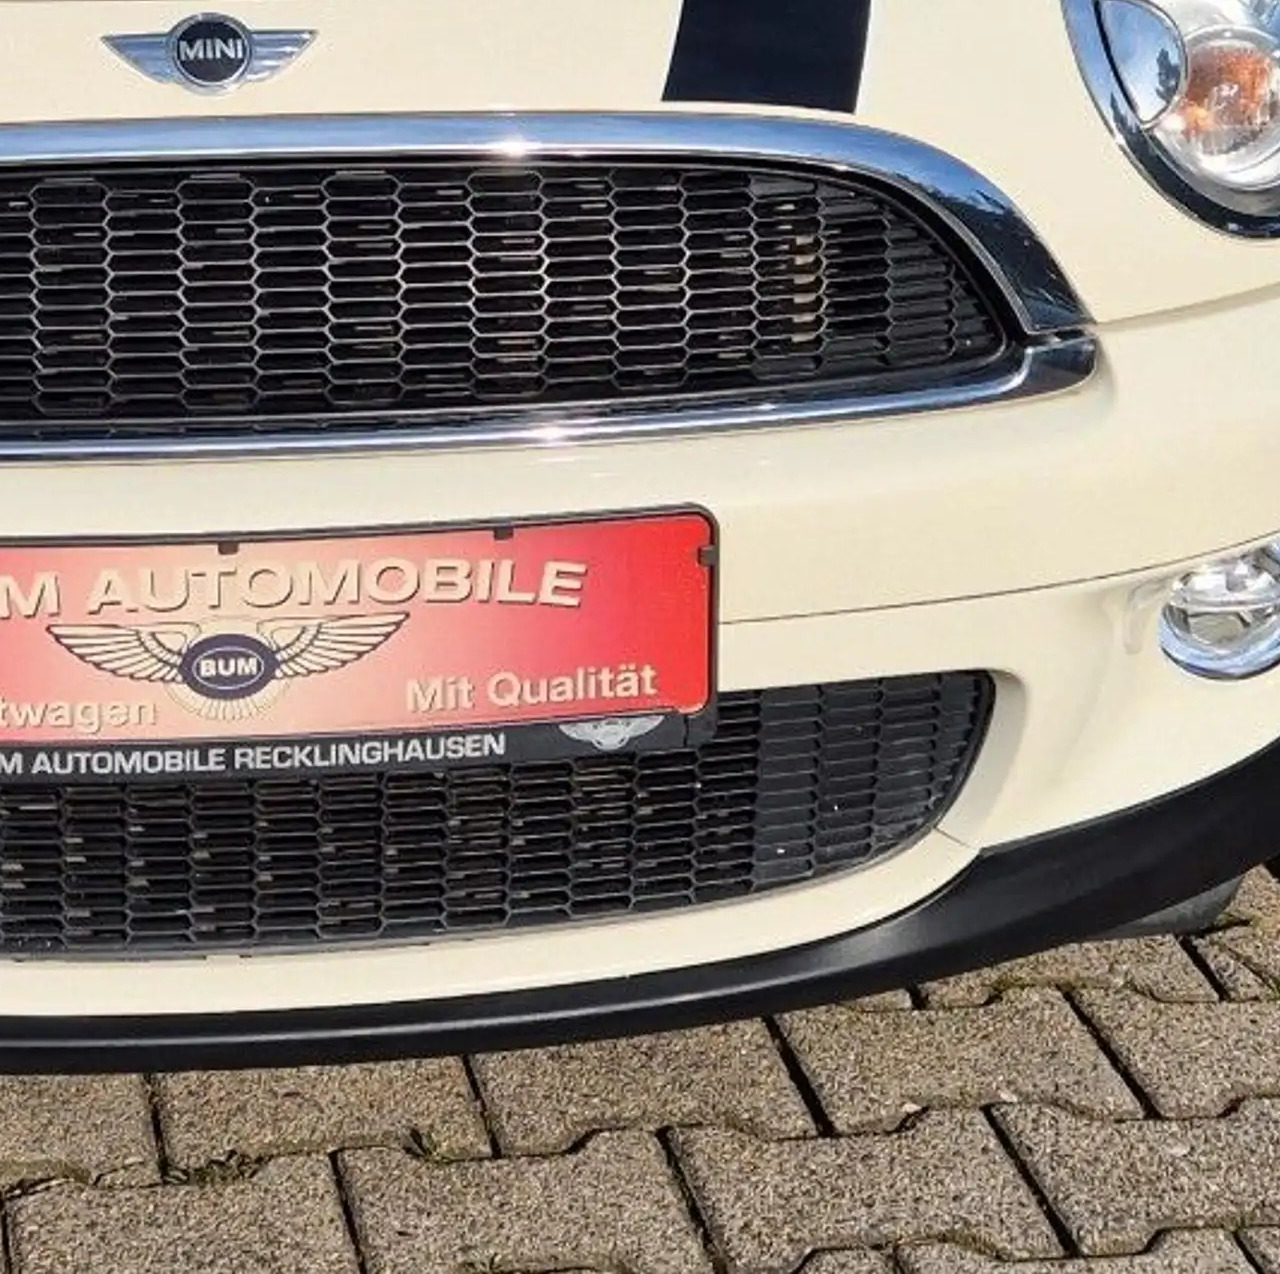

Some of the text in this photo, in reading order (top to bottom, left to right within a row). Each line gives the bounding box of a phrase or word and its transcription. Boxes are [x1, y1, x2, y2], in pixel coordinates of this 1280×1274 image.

[178, 37, 244, 62] MINI
[87, 558, 588, 615] AUTOMOBILE
[198, 657, 259, 677] BUM
[405, 674, 476, 713] Mit
[488, 663, 658, 708] Qualität
[31, 747, 227, 774] AUTOMOBILE
[233, 731, 507, 771] RECKLINGHAUSEN
